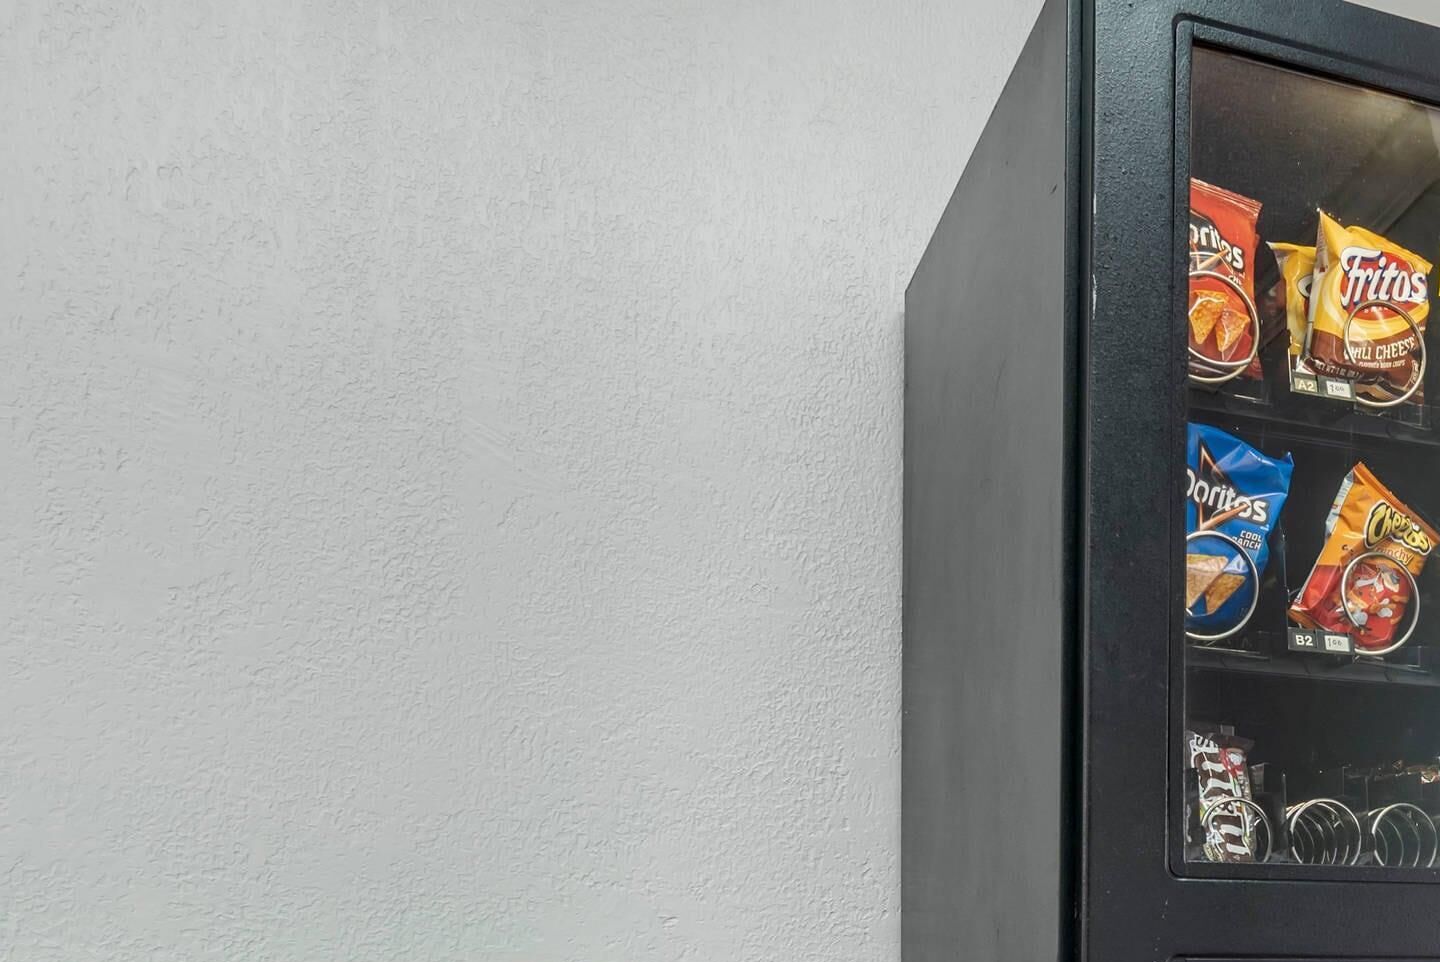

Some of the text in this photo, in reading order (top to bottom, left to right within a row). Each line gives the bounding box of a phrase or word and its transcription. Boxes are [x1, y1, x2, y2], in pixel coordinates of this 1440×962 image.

[1190, 223, 1244, 270] oritos
[1340, 246, 1428, 307] Fritos
[1299, 380, 1315, 392] A2
[1240, 530, 1262, 542] COOL
[1295, 635, 1314, 646] B2
